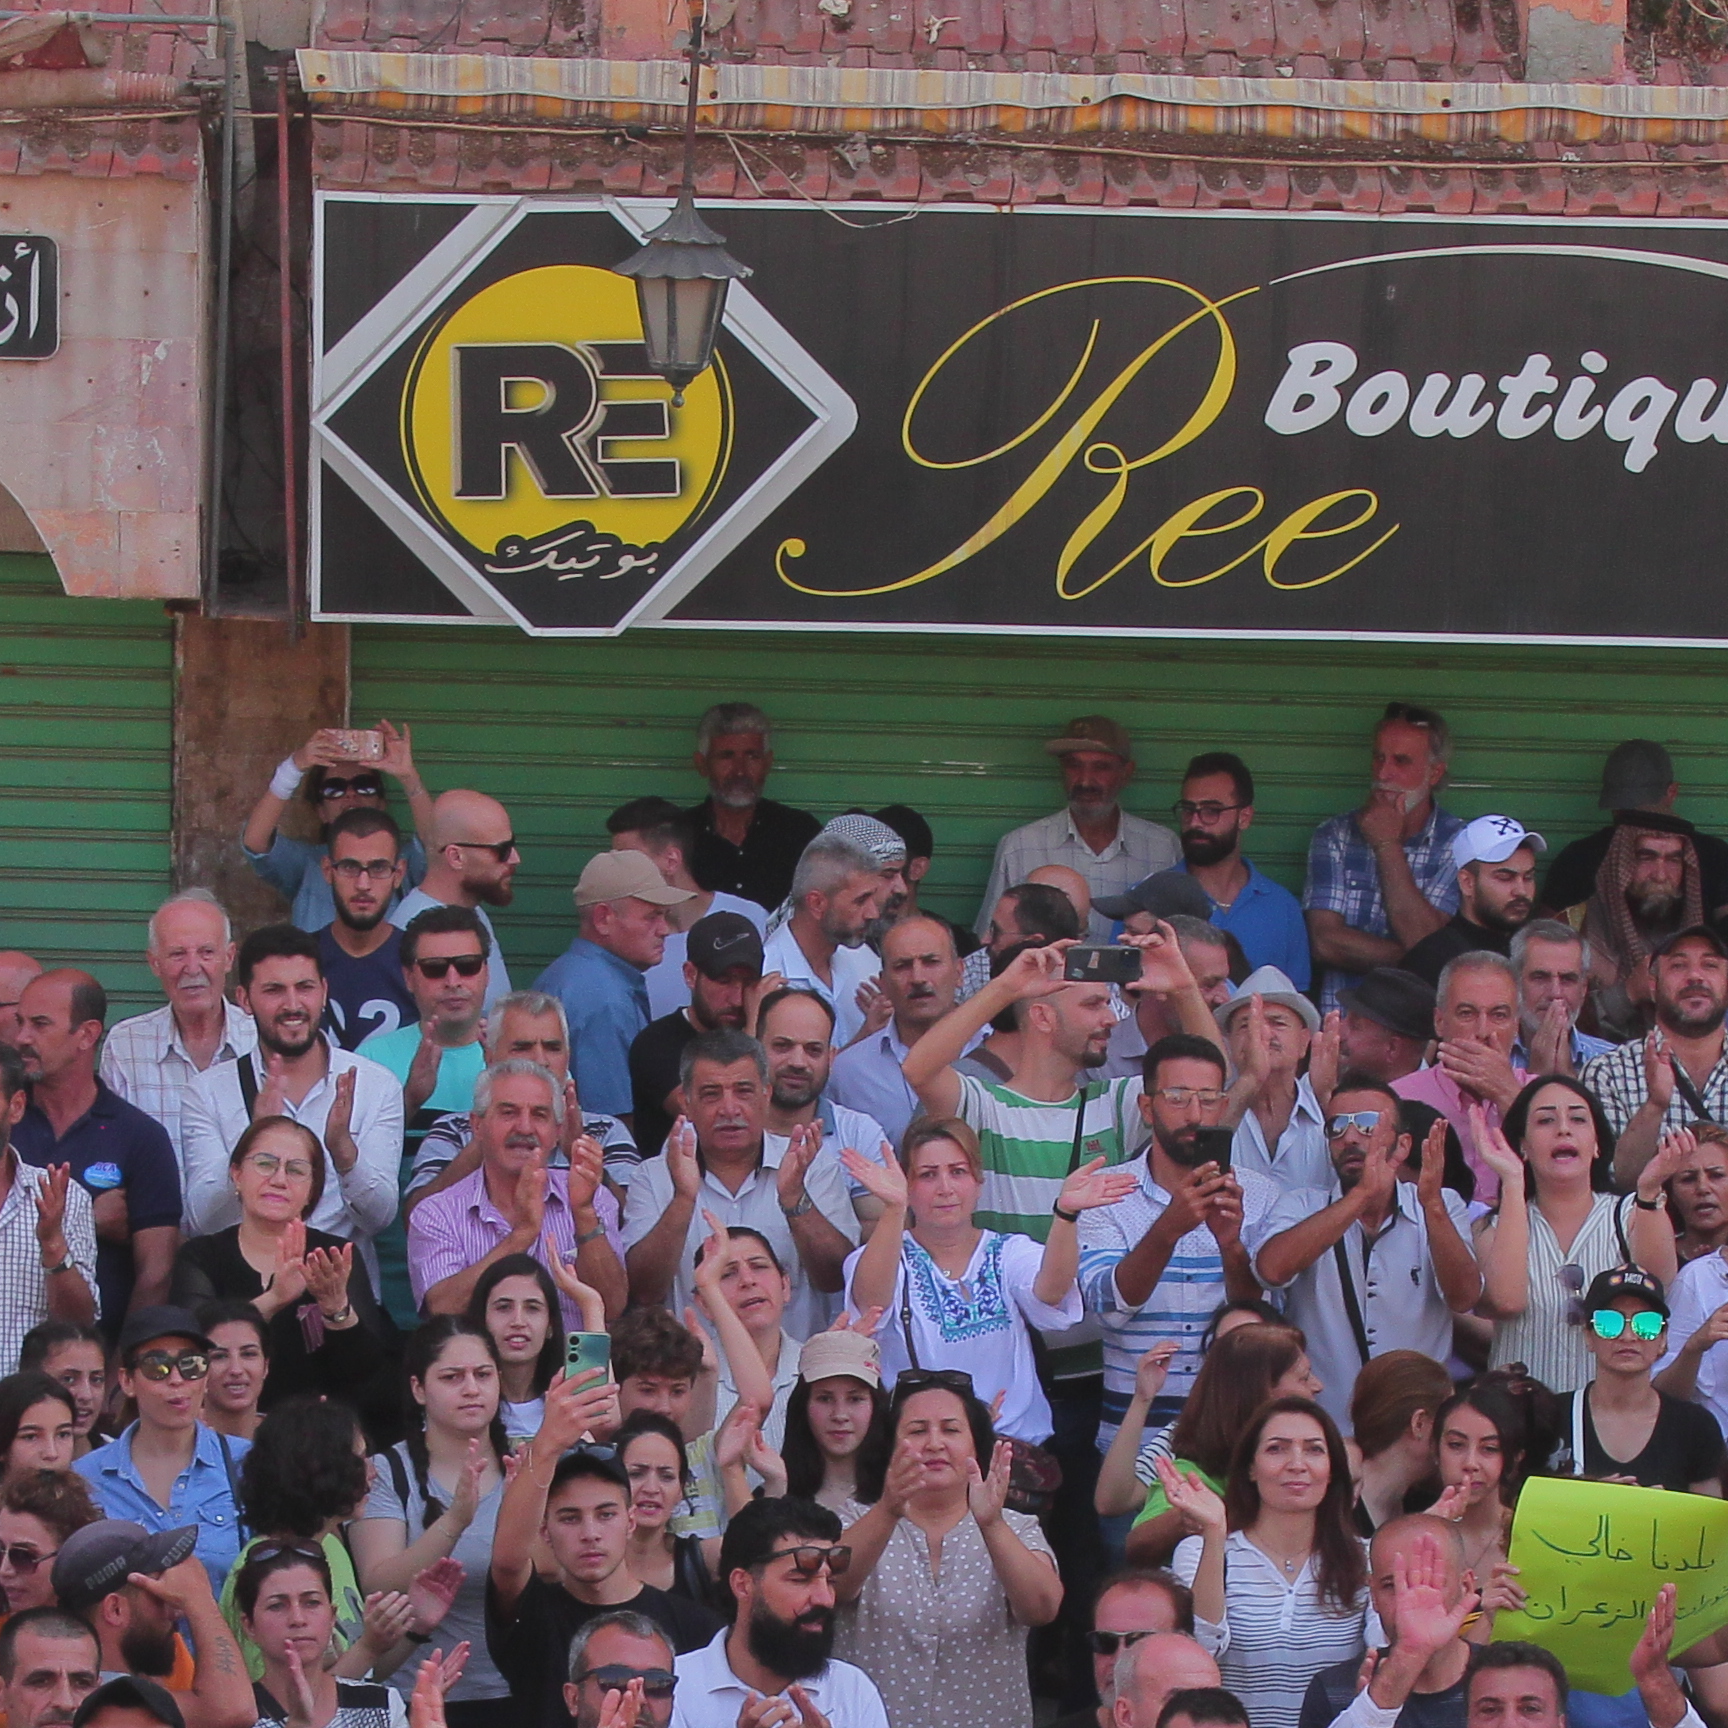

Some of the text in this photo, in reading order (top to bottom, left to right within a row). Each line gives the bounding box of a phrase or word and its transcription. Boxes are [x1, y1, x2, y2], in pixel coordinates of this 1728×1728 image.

[450, 340, 681, 500] RE
[775, 276, 1400, 599] Ree
[484, 529, 660, 580] بوتيك
